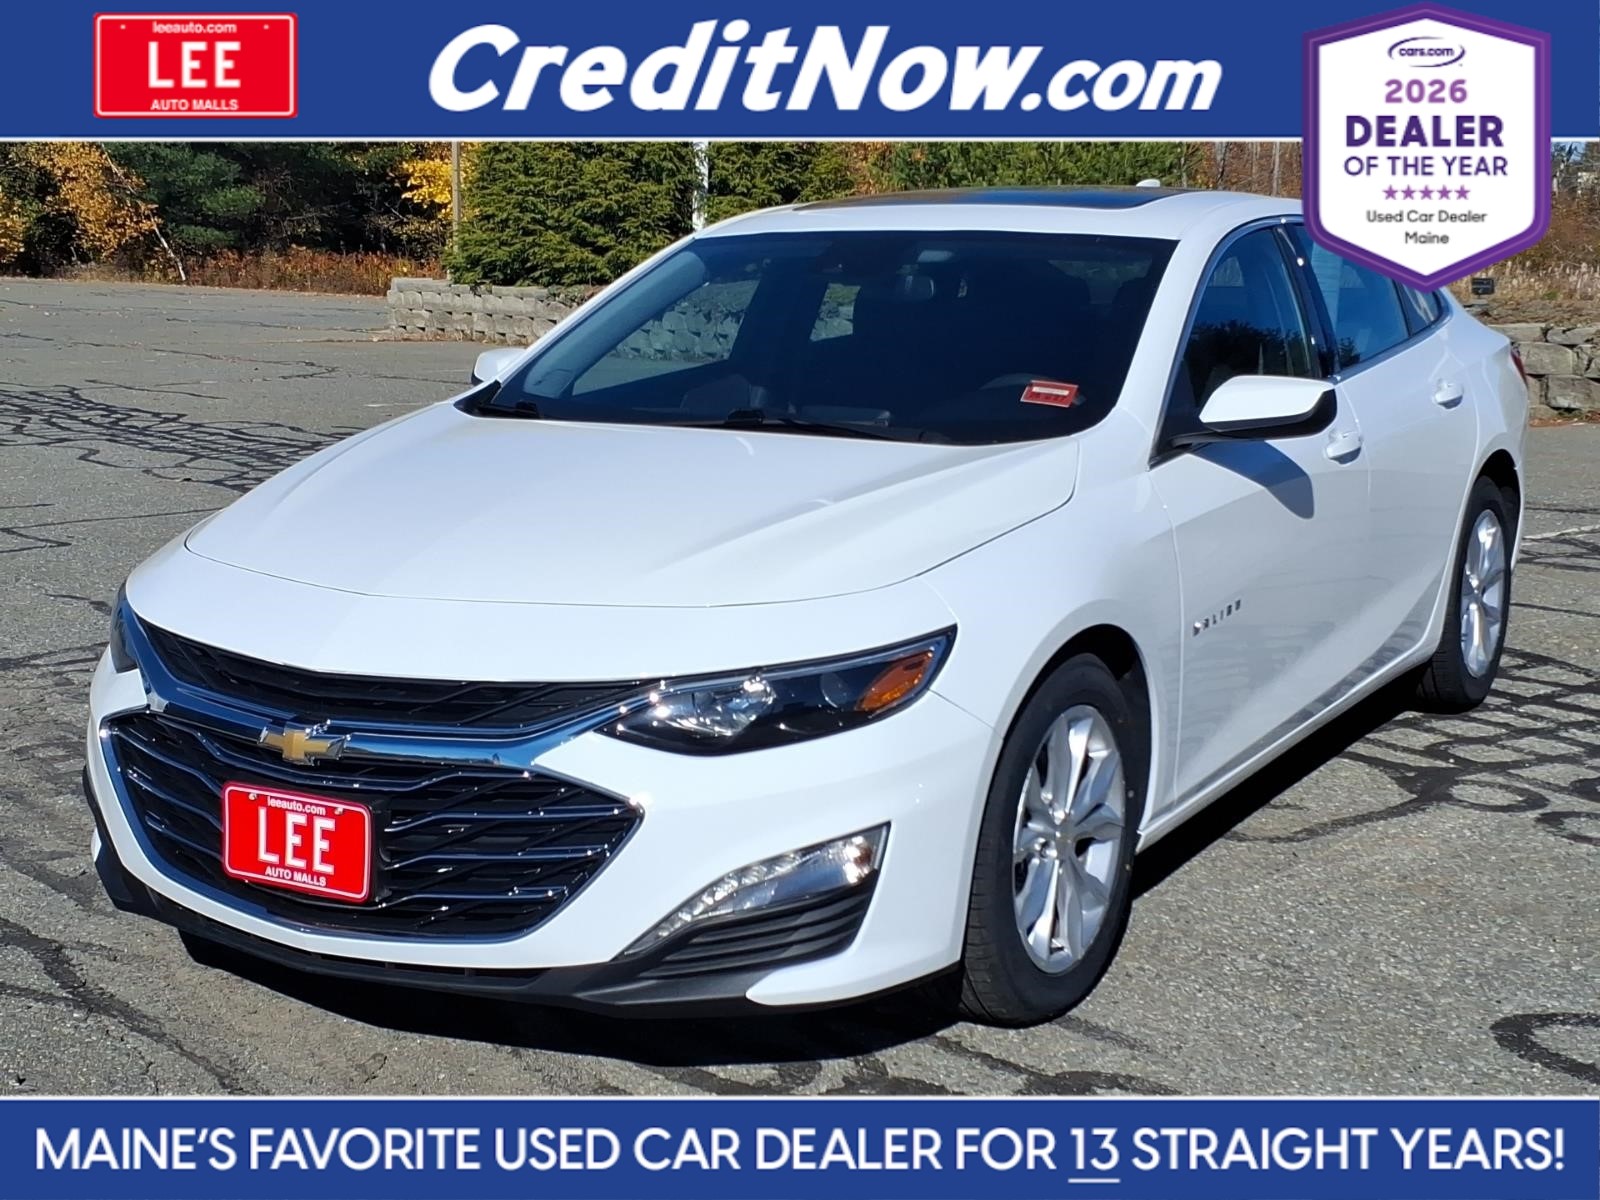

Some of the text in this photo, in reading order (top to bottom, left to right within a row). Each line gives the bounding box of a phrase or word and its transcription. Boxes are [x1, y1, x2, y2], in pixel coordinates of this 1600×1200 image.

[266, 796, 326, 816] leeauto.com
[258, 806, 336, 875] LEE
[264, 865, 327, 887] AUTO MALLS
